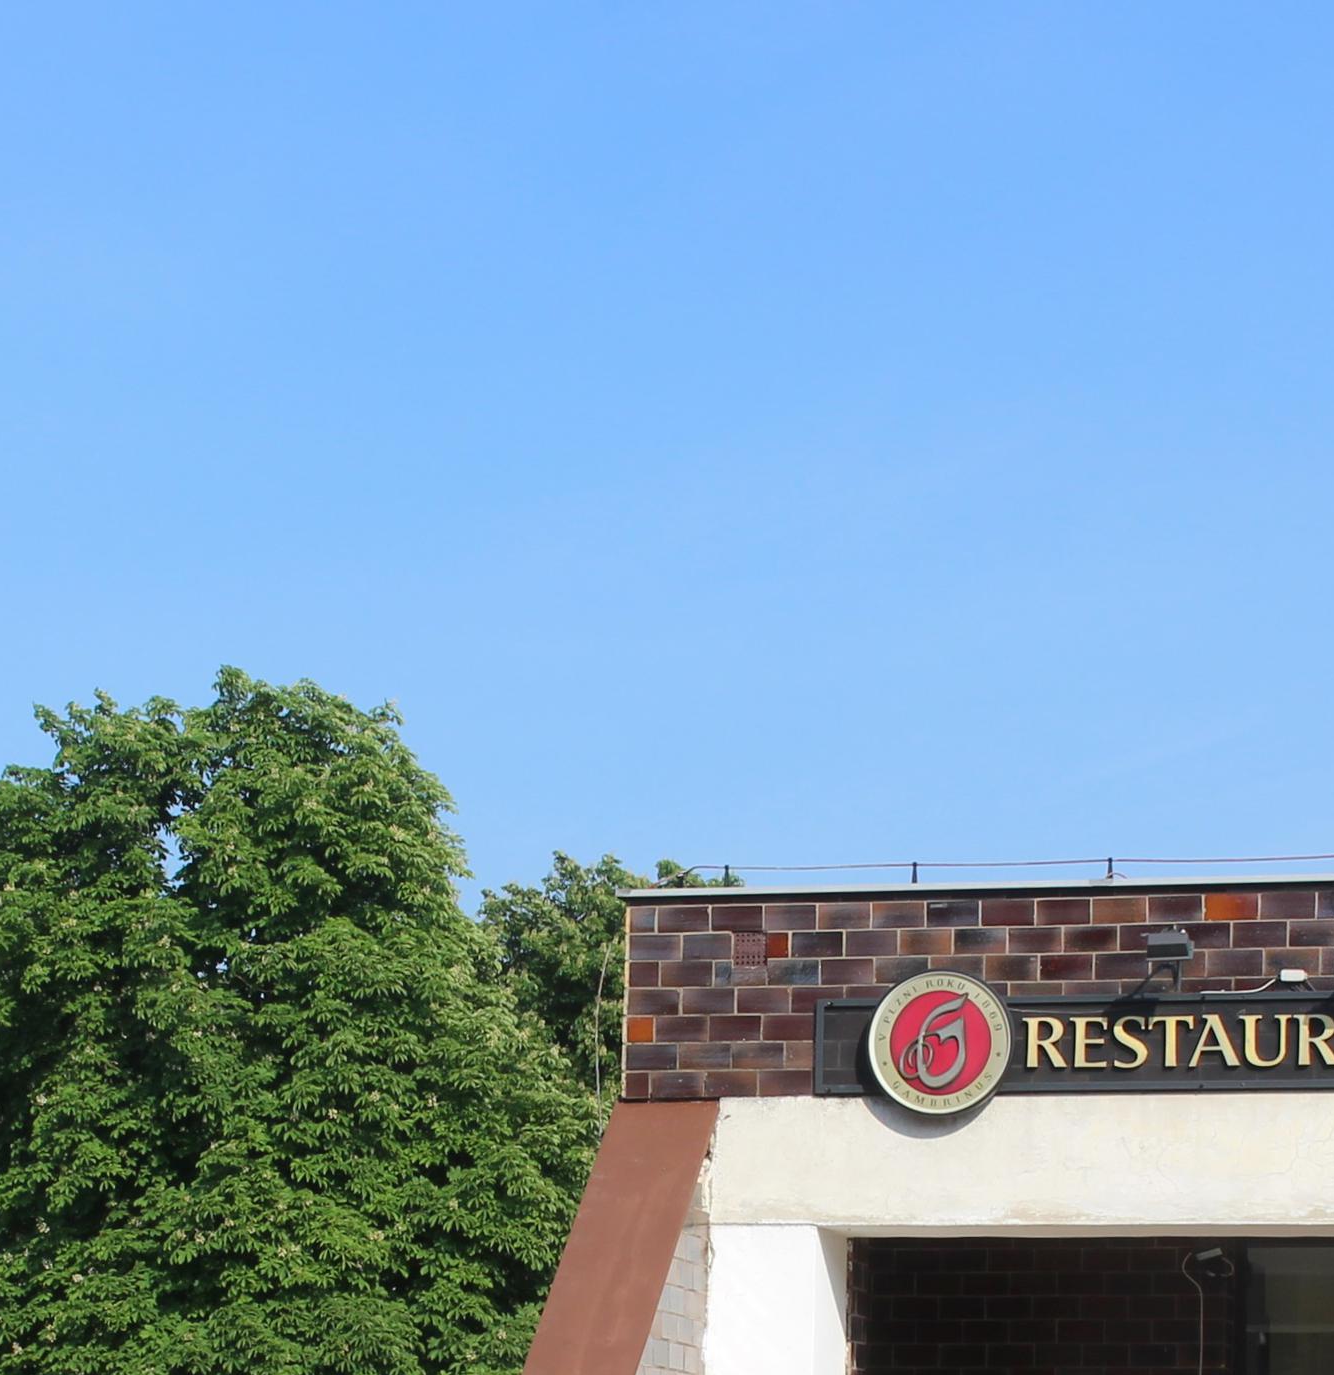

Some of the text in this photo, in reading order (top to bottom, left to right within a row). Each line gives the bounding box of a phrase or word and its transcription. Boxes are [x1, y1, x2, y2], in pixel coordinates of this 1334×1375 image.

[878, 1033, 887, 1043] V
[884, 986, 918, 1025] PLZNI
[925, 978, 966, 991] ROKU
[892, 1072, 994, 1108] GAMBRINUS
